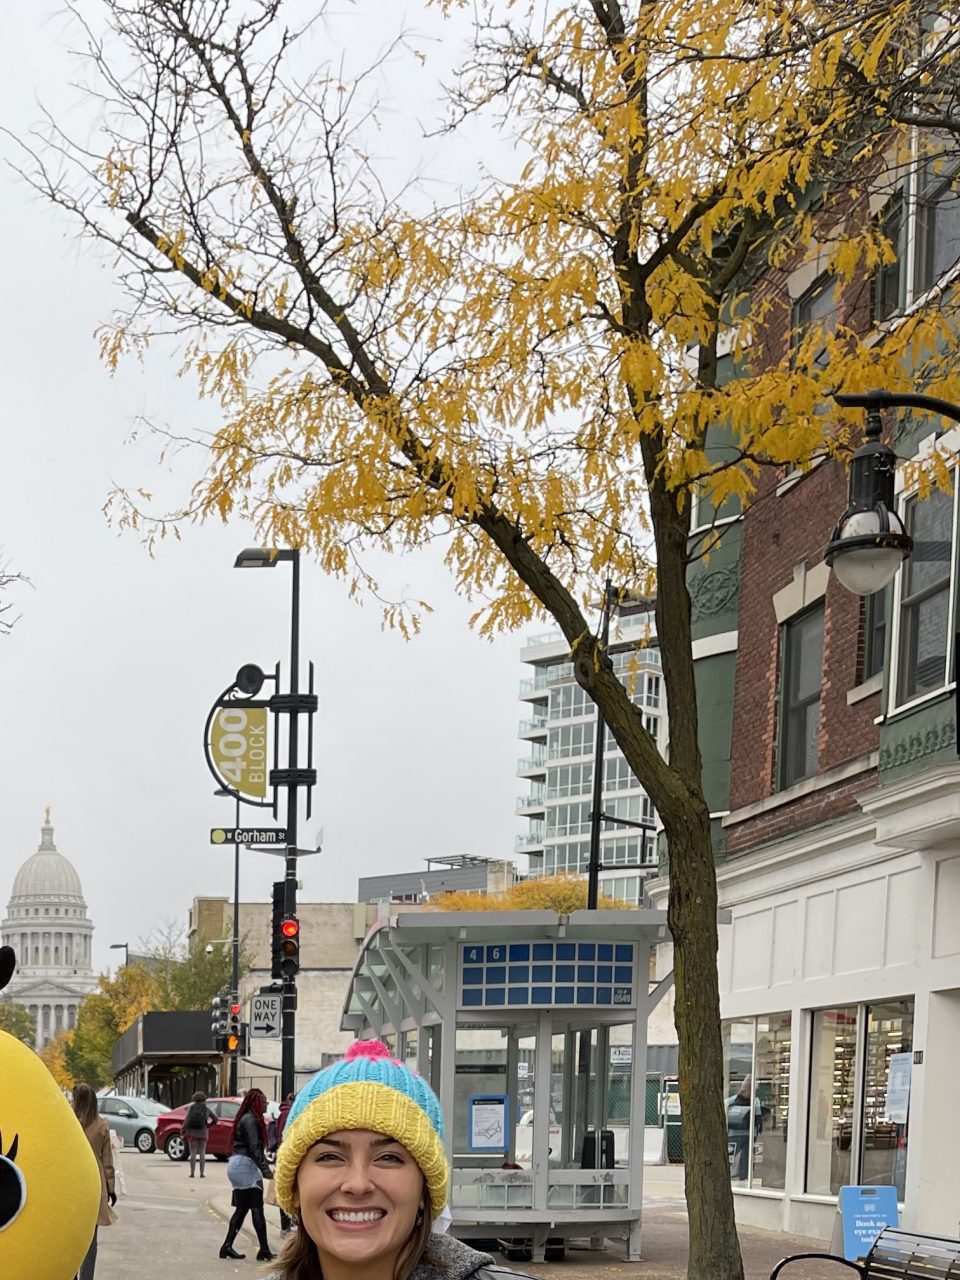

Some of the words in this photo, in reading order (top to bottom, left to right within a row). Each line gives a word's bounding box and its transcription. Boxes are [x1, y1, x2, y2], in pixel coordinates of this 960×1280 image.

[219, 708, 247, 782] 400
[249, 725, 265, 782] BLOCK
[235, 829, 276, 842] Gorham
[470, 949, 477, 960] 4
[493, 947, 500, 959] 6
[255, 1000, 277, 1010] ONE
[254, 1012, 277, 1022] WAY
